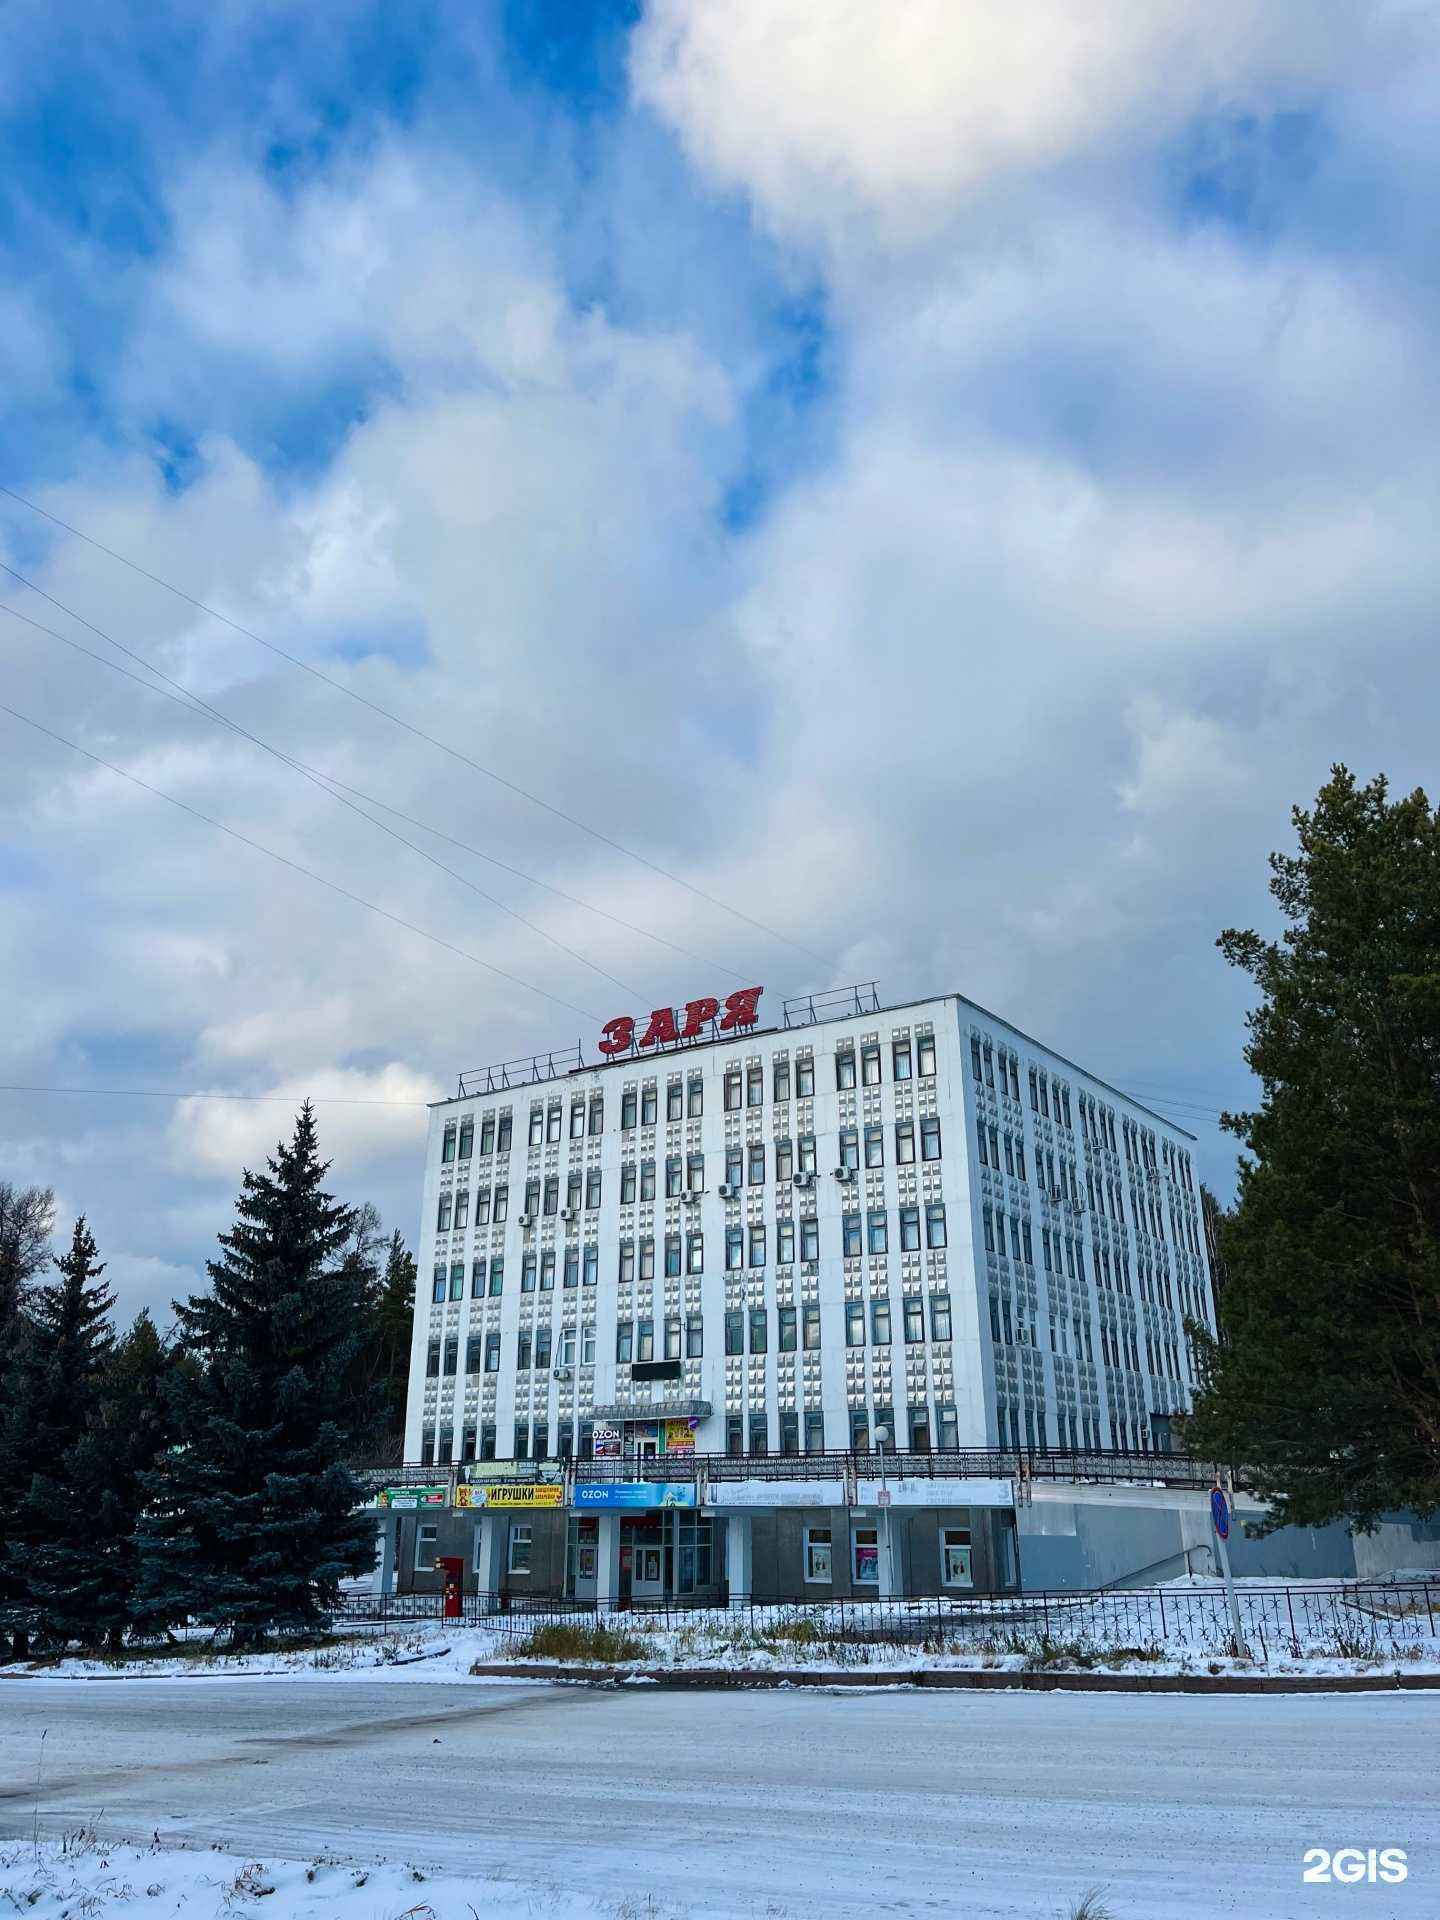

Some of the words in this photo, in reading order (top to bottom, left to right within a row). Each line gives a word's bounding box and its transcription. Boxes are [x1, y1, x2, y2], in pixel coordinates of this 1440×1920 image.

[598, 986, 764, 1055] ЗАРЯ
[592, 1429, 620, 1439] OZON
[490, 1487, 534, 1501] ИГРУШКИ
[581, 1489, 609, 1499] OZON
